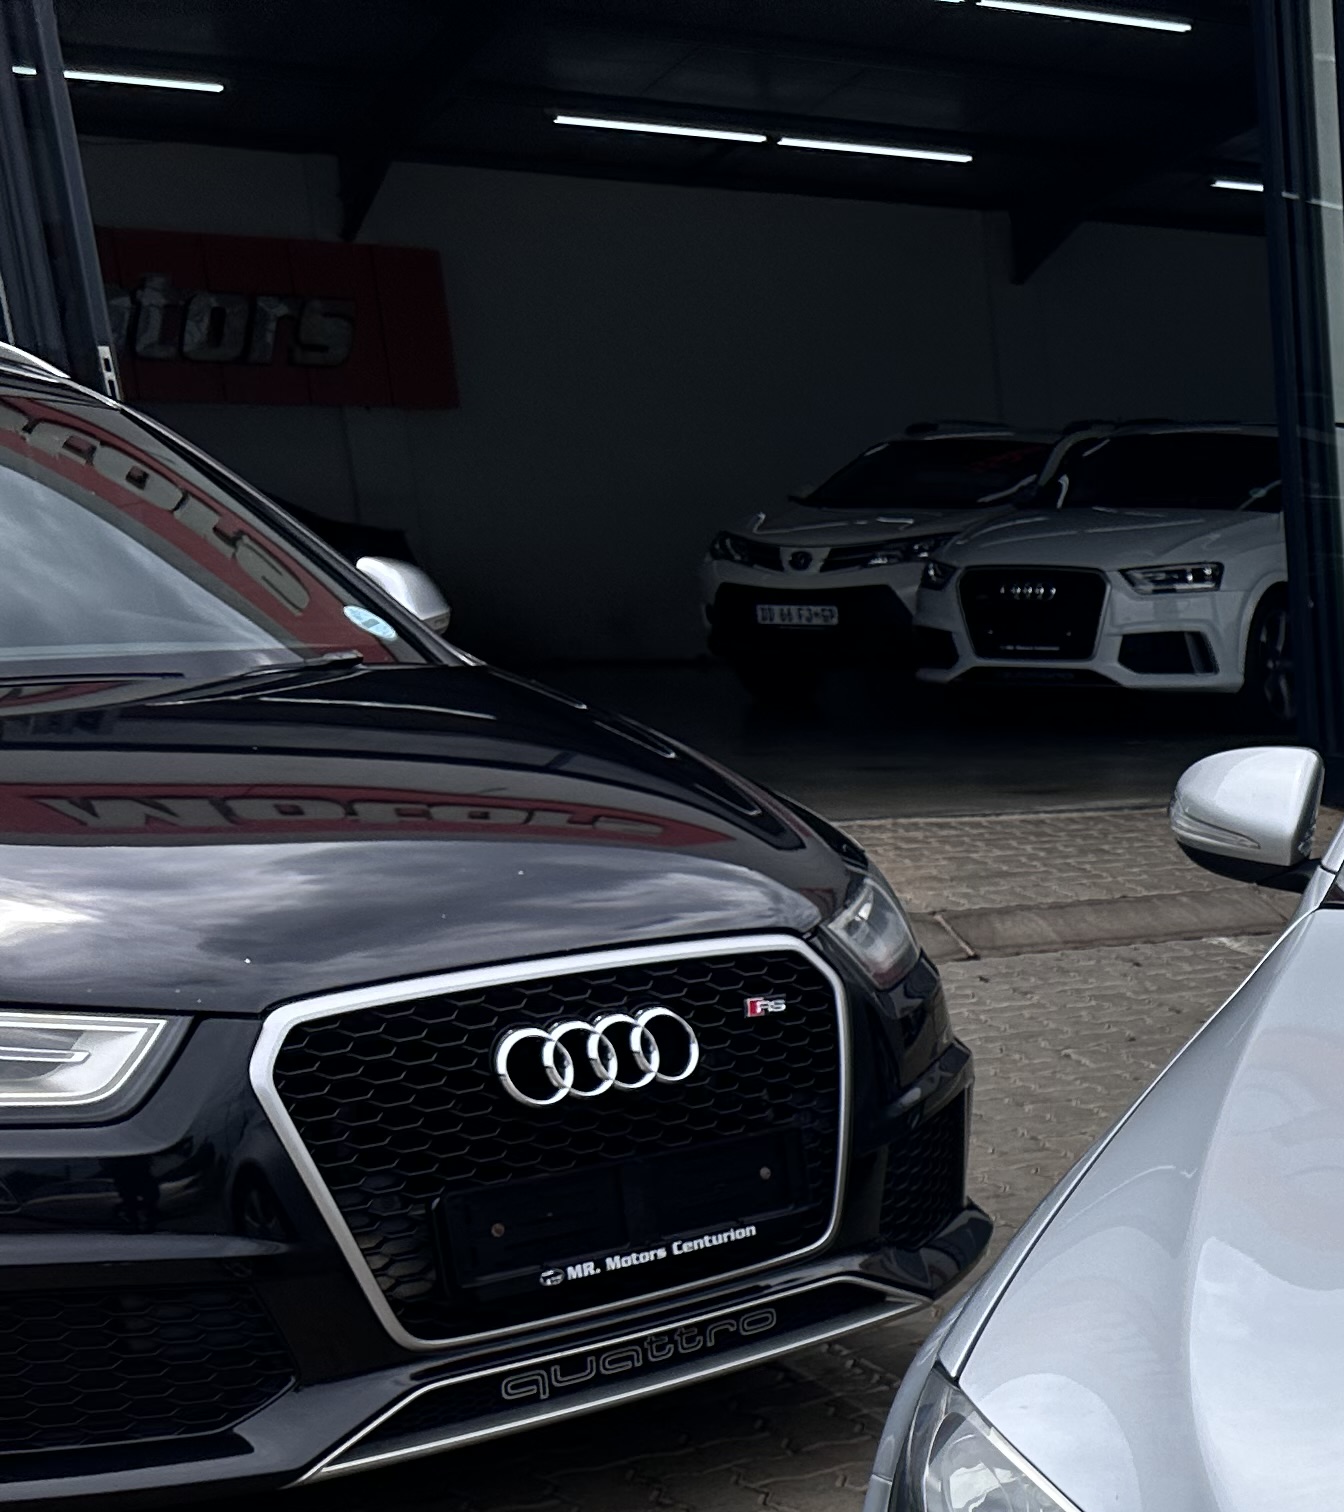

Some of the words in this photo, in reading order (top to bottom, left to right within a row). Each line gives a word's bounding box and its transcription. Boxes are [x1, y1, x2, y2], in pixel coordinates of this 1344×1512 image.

[752, 998, 786, 1014] RS
[566, 1261, 602, 1281] MR.
[605, 1246, 667, 1271] Motors
[672, 1225, 757, 1256] Centurion
[501, 1308, 777, 1400] quattro
